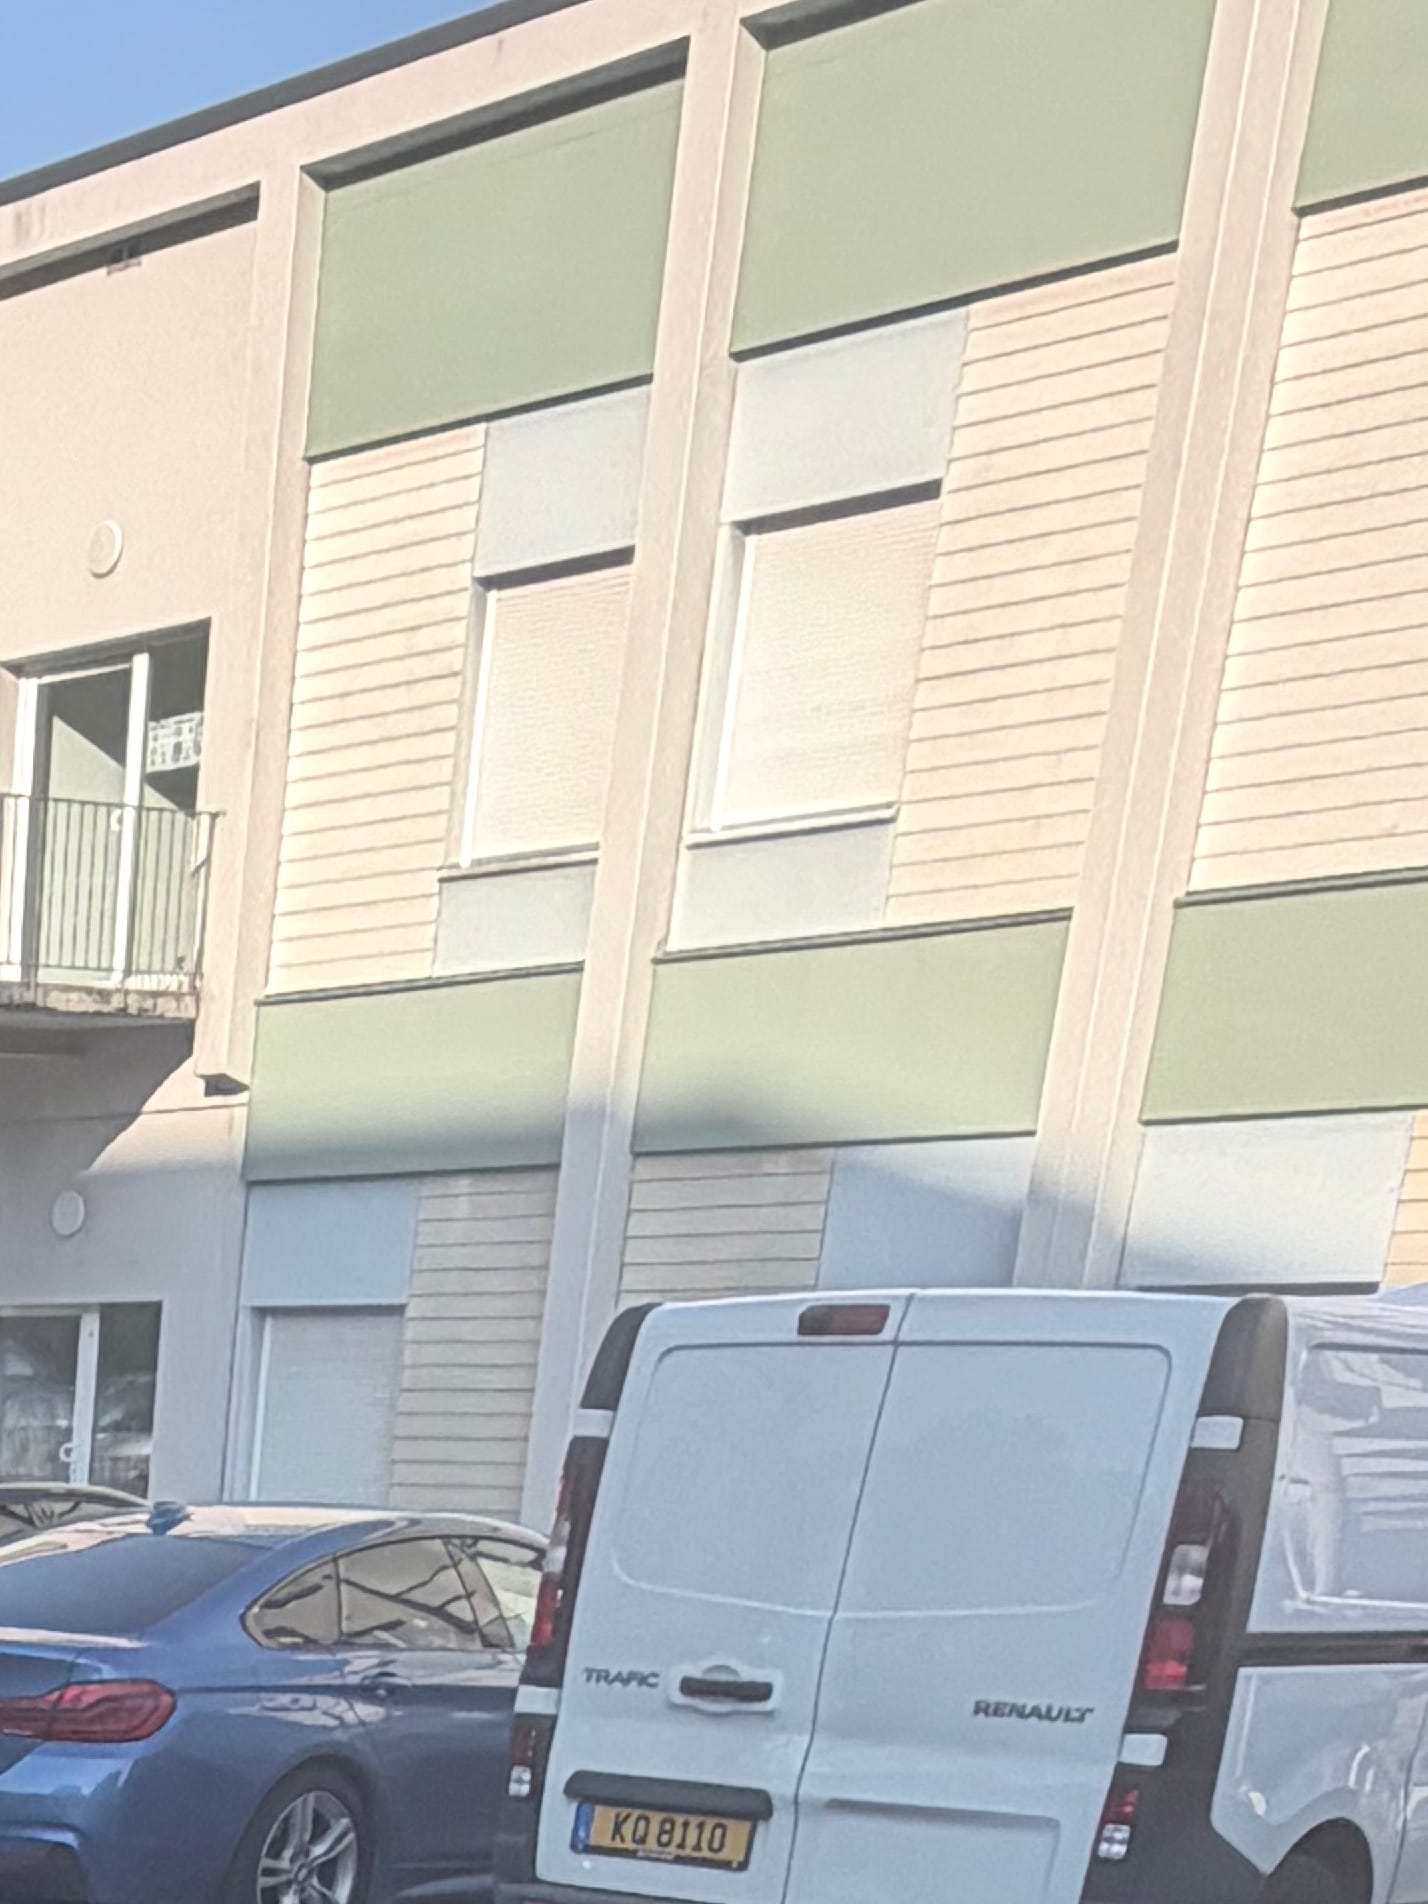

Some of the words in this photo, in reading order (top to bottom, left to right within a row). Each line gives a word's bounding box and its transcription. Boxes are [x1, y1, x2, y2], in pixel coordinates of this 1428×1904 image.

[582, 1666, 661, 1689] TRAFIC
[972, 1699, 1095, 1724] RENAULT
[656, 1815, 728, 1854] 8110
